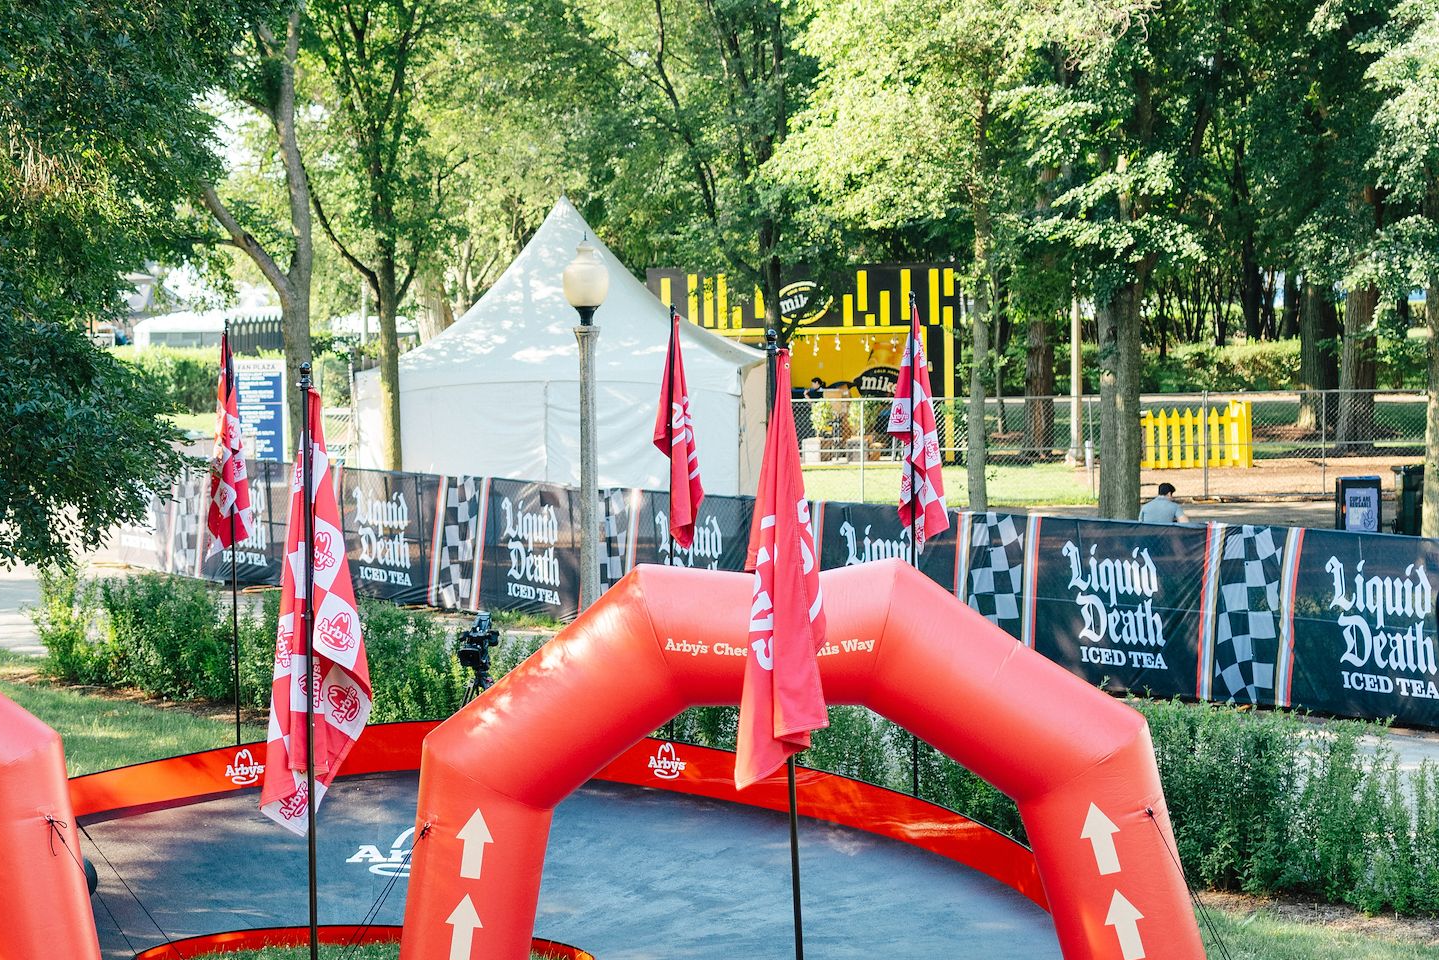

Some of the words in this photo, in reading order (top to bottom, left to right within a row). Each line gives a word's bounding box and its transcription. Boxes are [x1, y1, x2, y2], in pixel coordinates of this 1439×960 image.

[861, 376, 898, 395] mike
[352, 486, 409, 537] Liquid
[501, 496, 558, 552] Liquid
[358, 525, 411, 569] Death
[655, 510, 722, 567] Luid
[246, 553, 268, 567] TEA
[507, 538, 560, 587] Death
[1062, 540, 1158, 608] Liquid
[359, 566, 388, 583] ICED
[388, 570, 412, 587] TEA
[1325, 555, 1432, 629] Liquid
[507, 582, 536, 600] ICED
[536, 588, 561, 606] TEA
[318, 617, 356, 649] Arby's
[1075, 591, 1166, 648] Death
[664, 637, 709, 657] Arby's
[841, 638, 876, 653] Way
[1080, 645, 1127, 667] ICED
[1128, 650, 1169, 670] TEA
[1338, 612, 1438, 676] Death
[1341, 670, 1394, 694] ICED
[1395, 677, 1439, 700] TEA
[332, 686, 357, 723] Arby's
[225, 761, 265, 777] Arby's
[648, 755, 687, 773] Arby's
